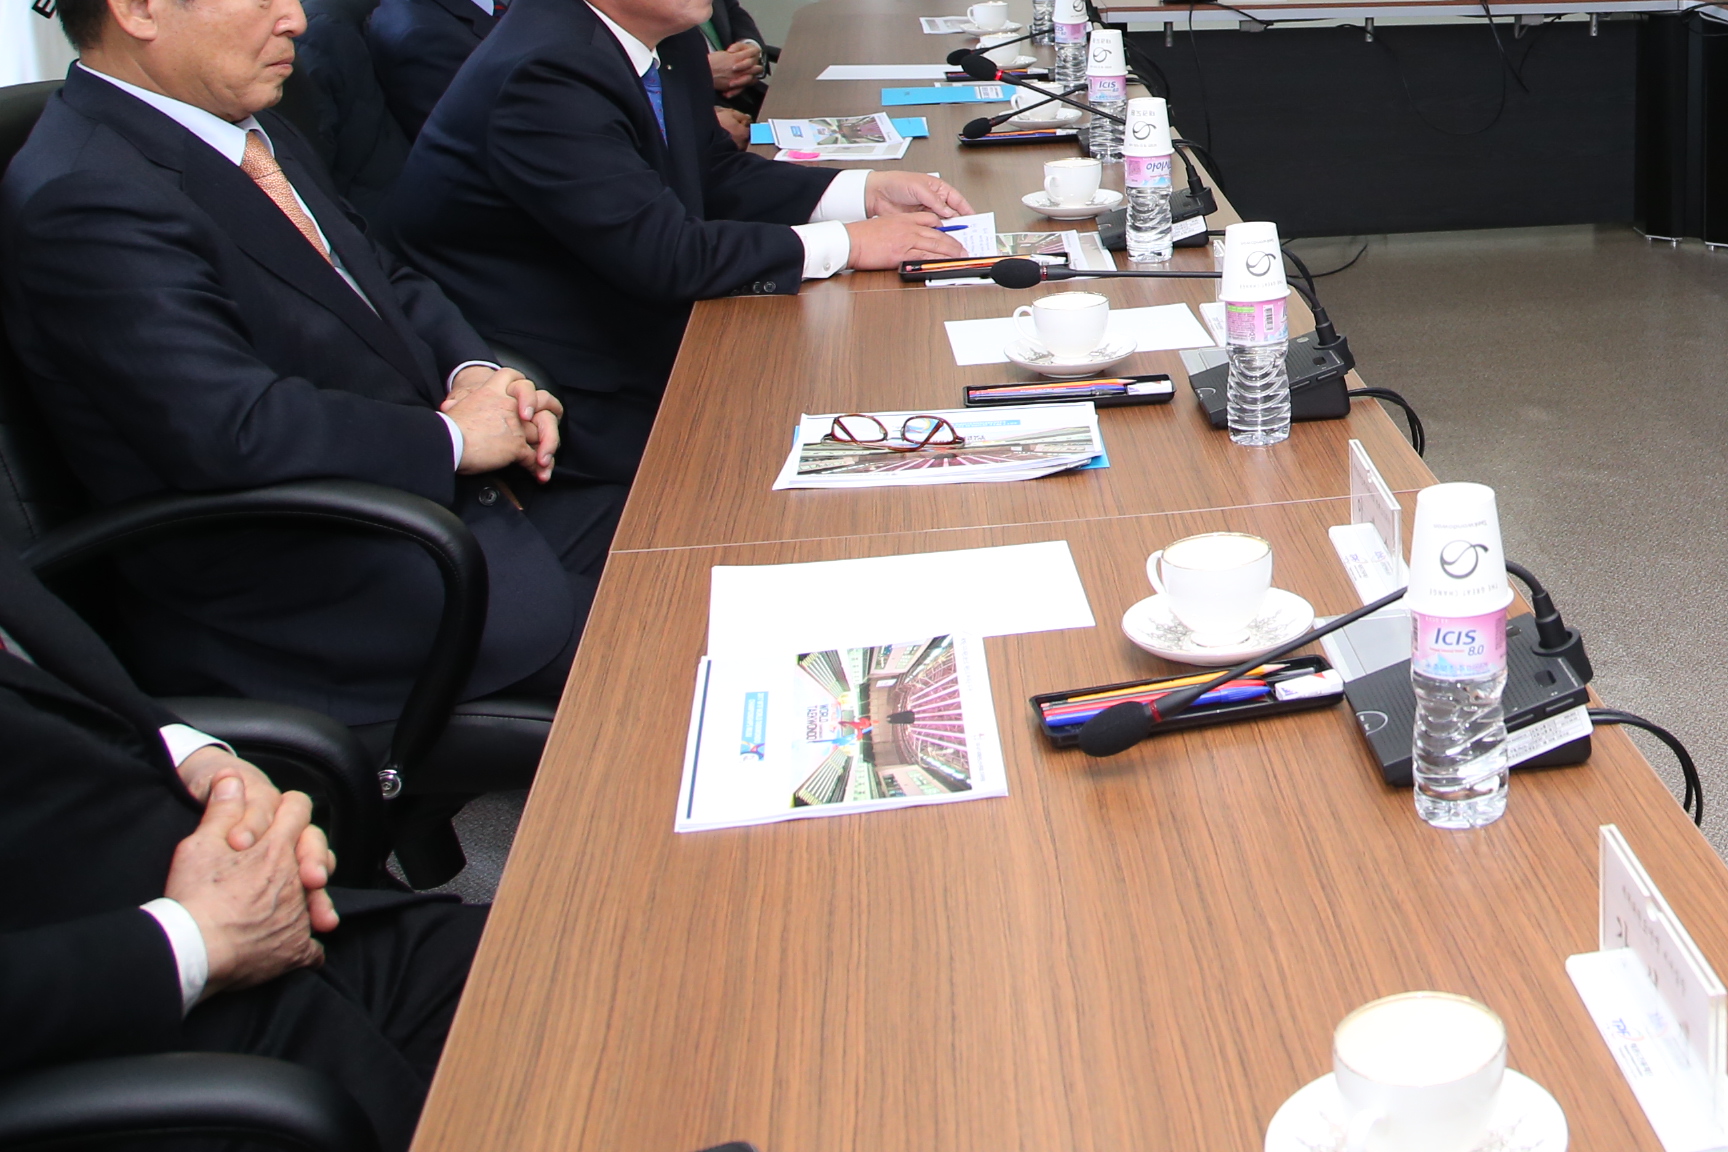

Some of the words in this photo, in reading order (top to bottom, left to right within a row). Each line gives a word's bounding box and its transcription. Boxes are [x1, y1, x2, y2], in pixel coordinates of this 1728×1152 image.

[1099, 80, 1117, 89] ICIS
[1434, 627, 1477, 646] ICIS
[1467, 644, 1485, 657] 8.0
